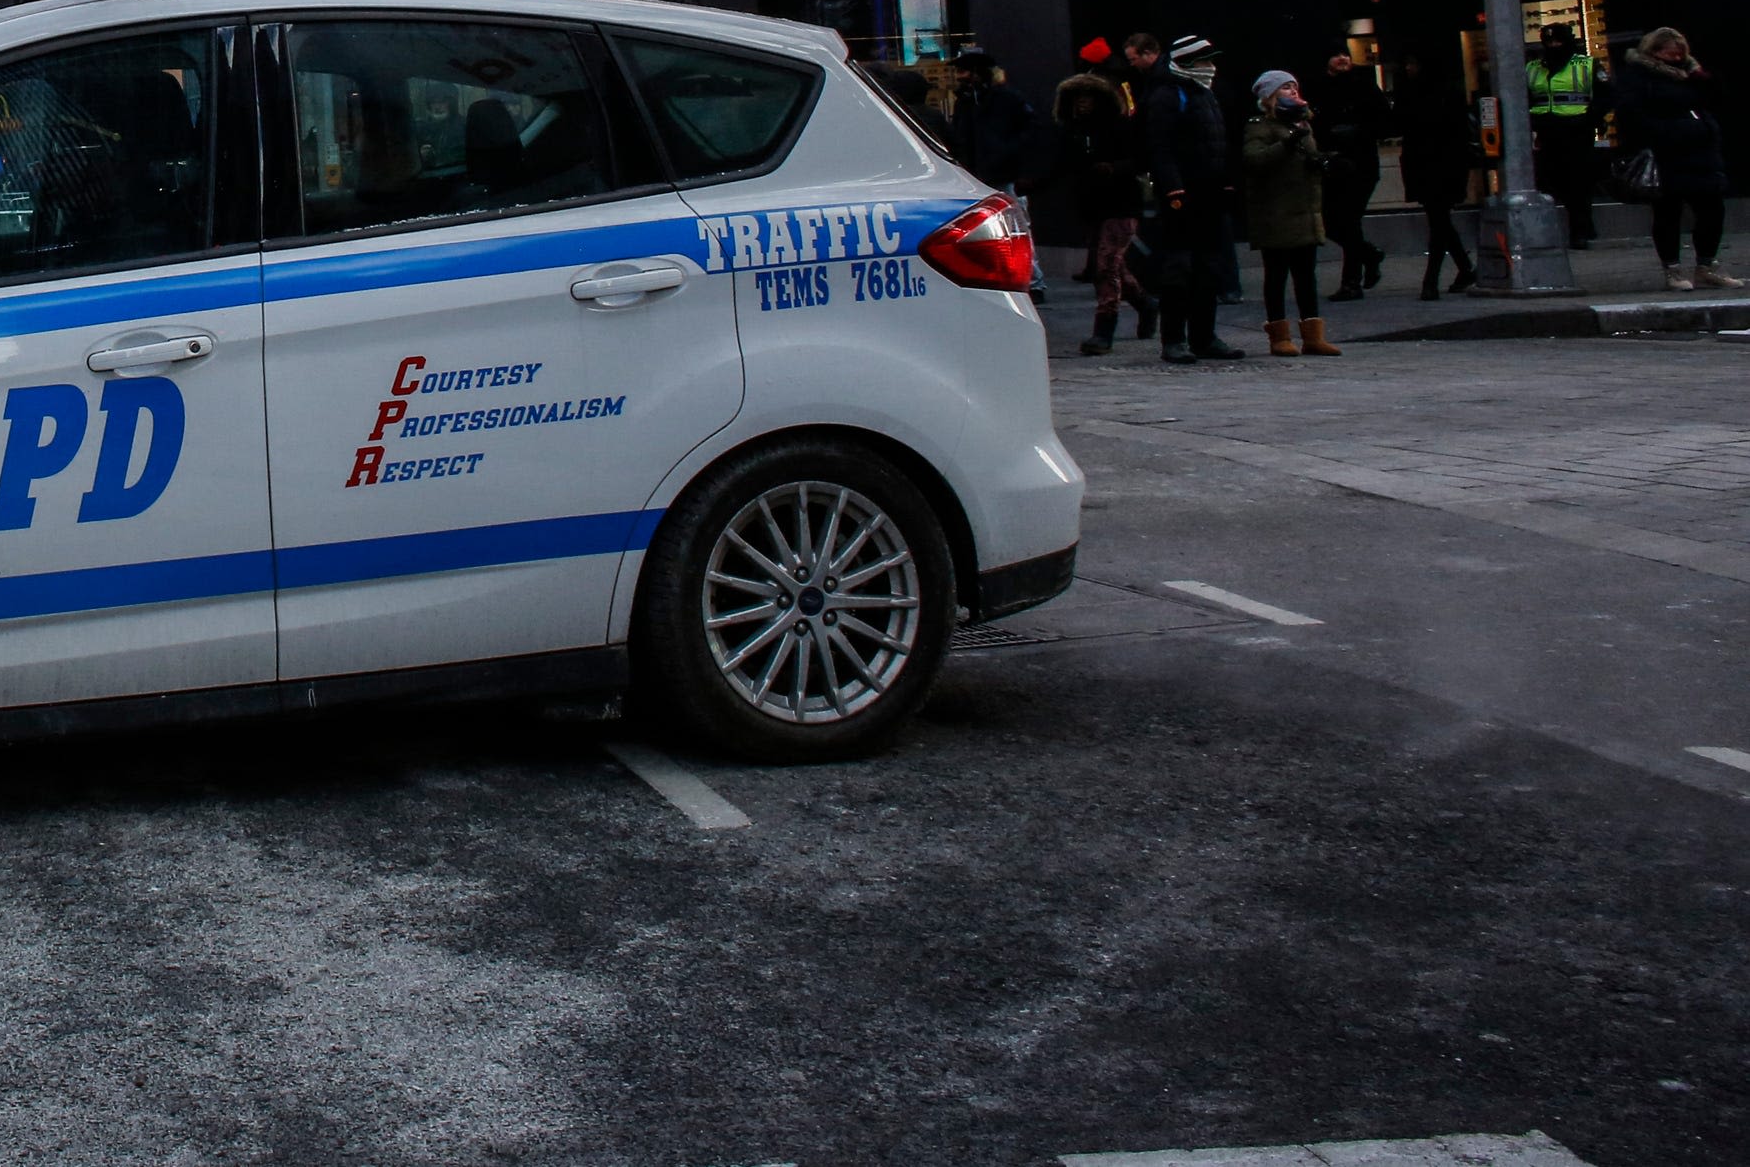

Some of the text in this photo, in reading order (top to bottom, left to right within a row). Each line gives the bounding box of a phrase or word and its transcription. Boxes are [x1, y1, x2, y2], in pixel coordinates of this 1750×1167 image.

[697, 202, 901, 272] TRAFFIC
[756, 264, 830, 312] TEMS
[390, 354, 542, 397] COURTESY
[367, 394, 626, 441] PROFESSIONALISM
[344, 444, 485, 489] RESPECT
